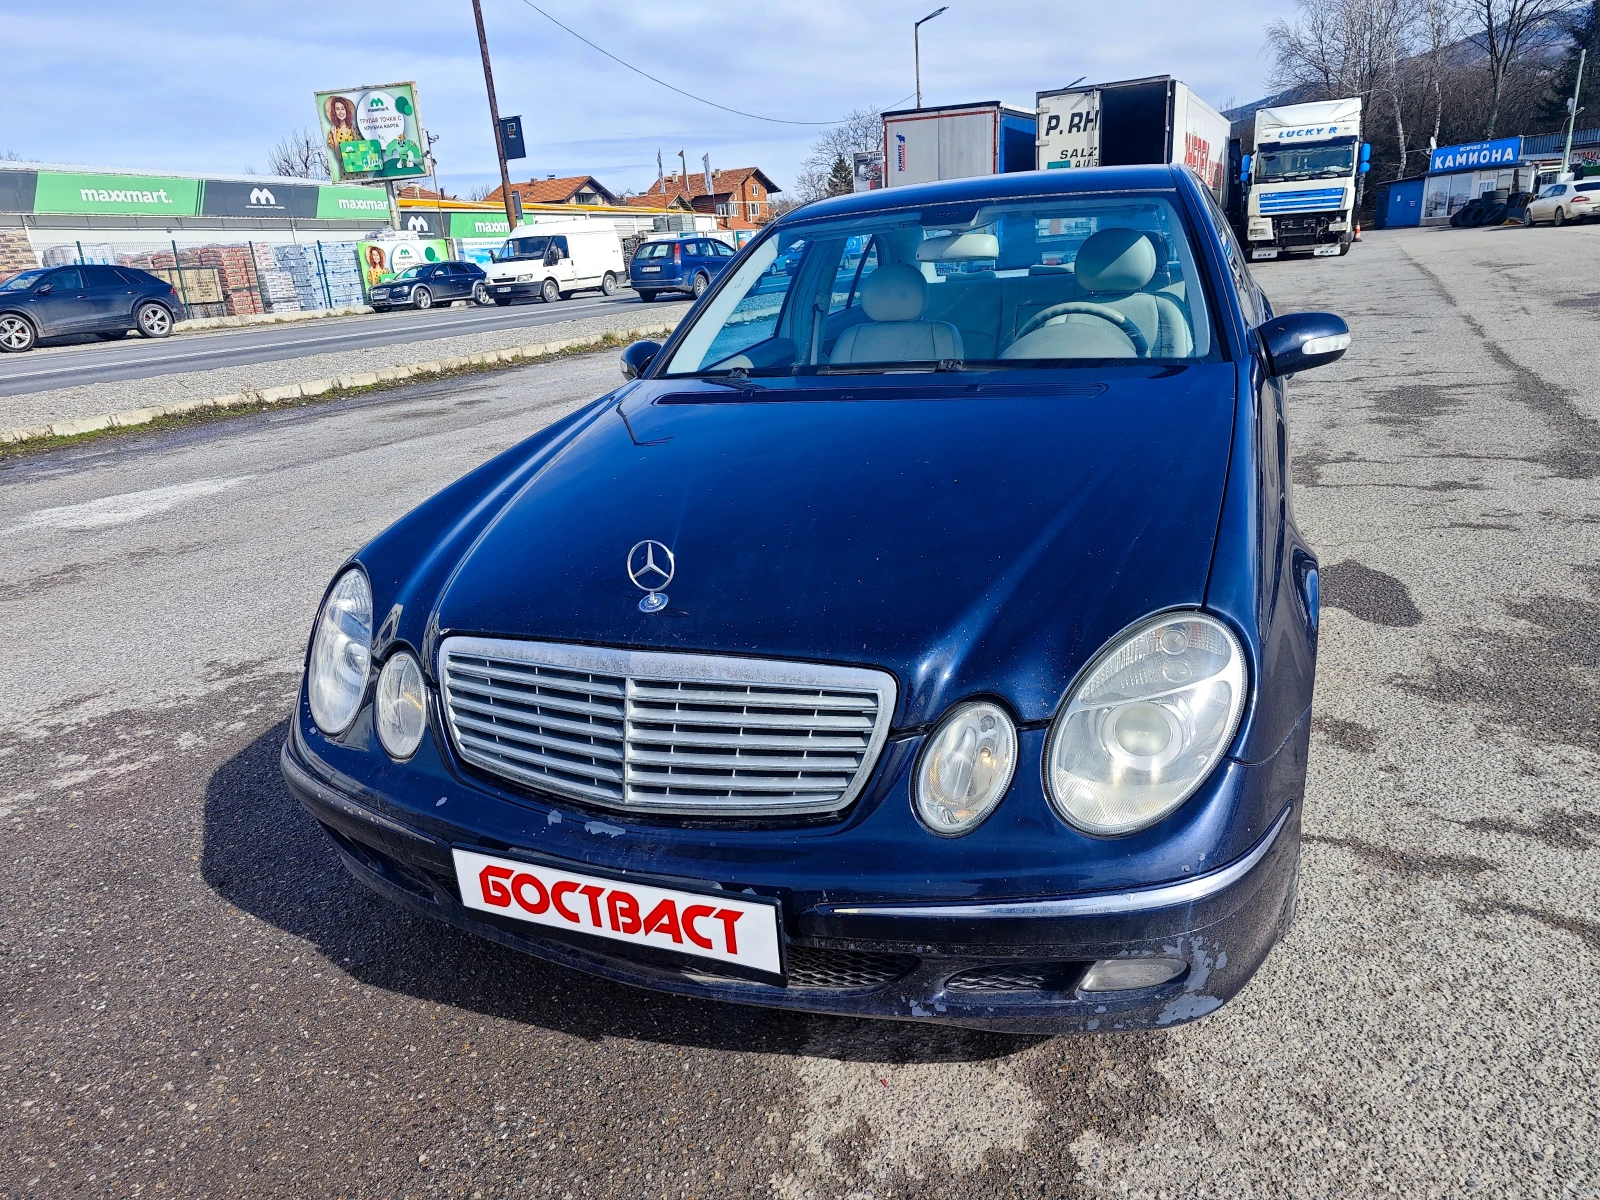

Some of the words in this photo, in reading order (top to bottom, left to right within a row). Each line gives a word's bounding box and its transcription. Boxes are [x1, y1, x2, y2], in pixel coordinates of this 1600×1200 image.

[1279, 128, 1324, 138] LUCKY
[1060, 147, 1098, 160] SALZ
[1435, 148, 1514, 170] КАМИОНА
[80, 188, 173, 204] maxxmart.
[338, 198, 389, 210] maxxmar
[474, 220, 524, 233] maxxm
